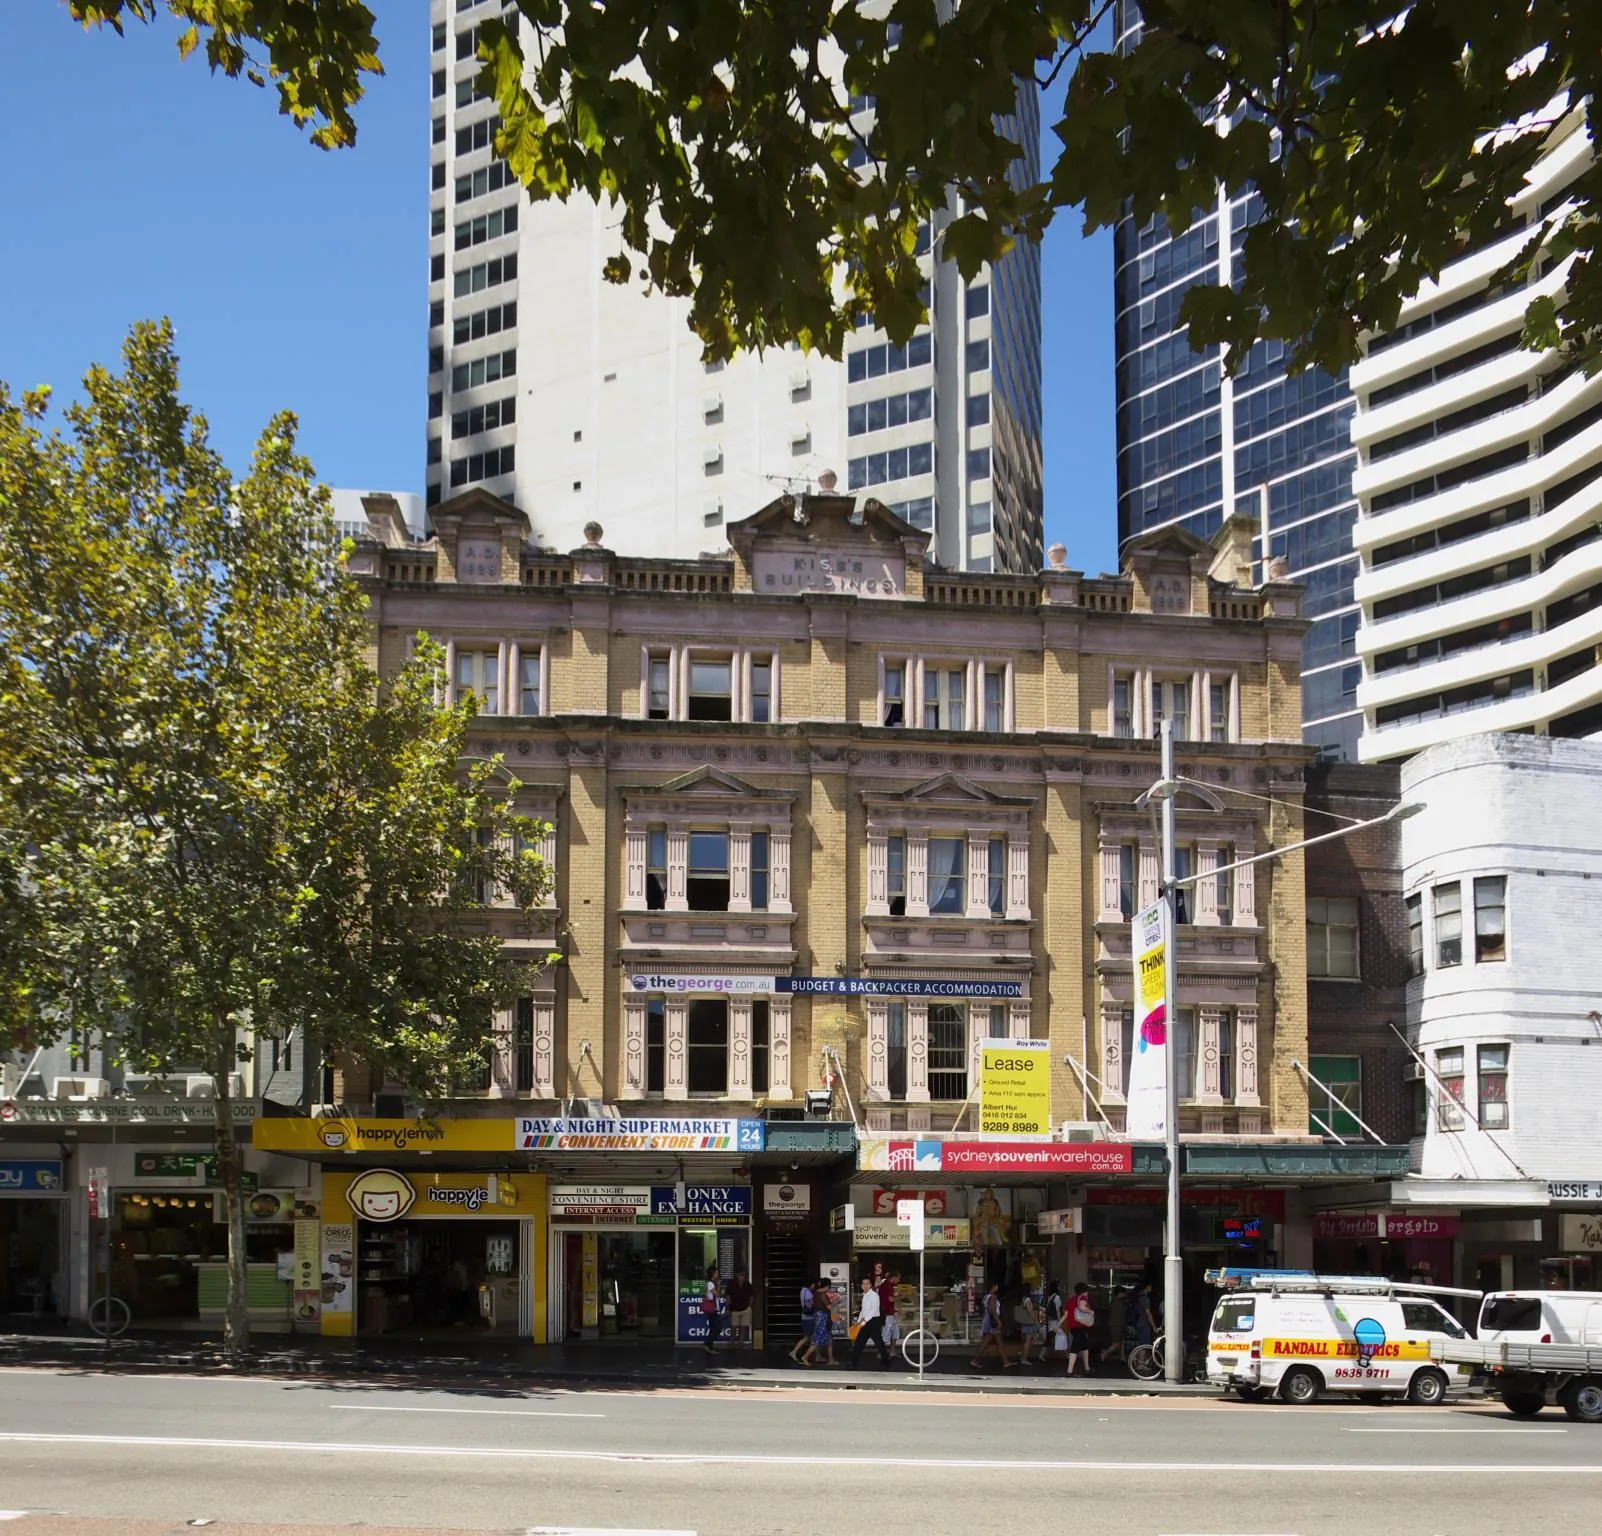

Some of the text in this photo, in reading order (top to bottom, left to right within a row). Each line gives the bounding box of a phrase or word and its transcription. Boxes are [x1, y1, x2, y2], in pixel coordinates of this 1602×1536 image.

[1139, 949, 1164, 974] THINK
[649, 976, 732, 991] thegeorge
[1141, 971, 1161, 987] GREEN
[791, 980, 1022, 996] BUDGET & BACKPACKER ACCOMMODATION
[984, 1055, 1034, 1071] Lease
[88, 1105, 128, 1116] CUISINE
[132, 1105, 160, 1116] COOL
[231, 1106, 256, 1116] OOD
[522, 1120, 731, 1134] DAY & NIGHT SUPERMARKET
[983, 1122, 1039, 1133] 9289 8989
[557, 1135, 696, 1149] CONVENIENT STORE
[741, 1129, 761, 1142] 24
[1548, 1183, 1588, 1198] AUSSIE
[427, 1186, 488, 1211] happyle
[553, 1196, 649, 1204] CONVENIENCE STORE
[658, 1202, 744, 1213] EXHANGE
[326, 1229, 349, 1237] OREO
[856, 1223, 883, 1233] sydney
[1387, 1219, 1439, 1235] argain
[1274, 1341, 1400, 1357] RANDALL ELECTRICS
[1334, 1368, 1390, 1379] 9838 9711
